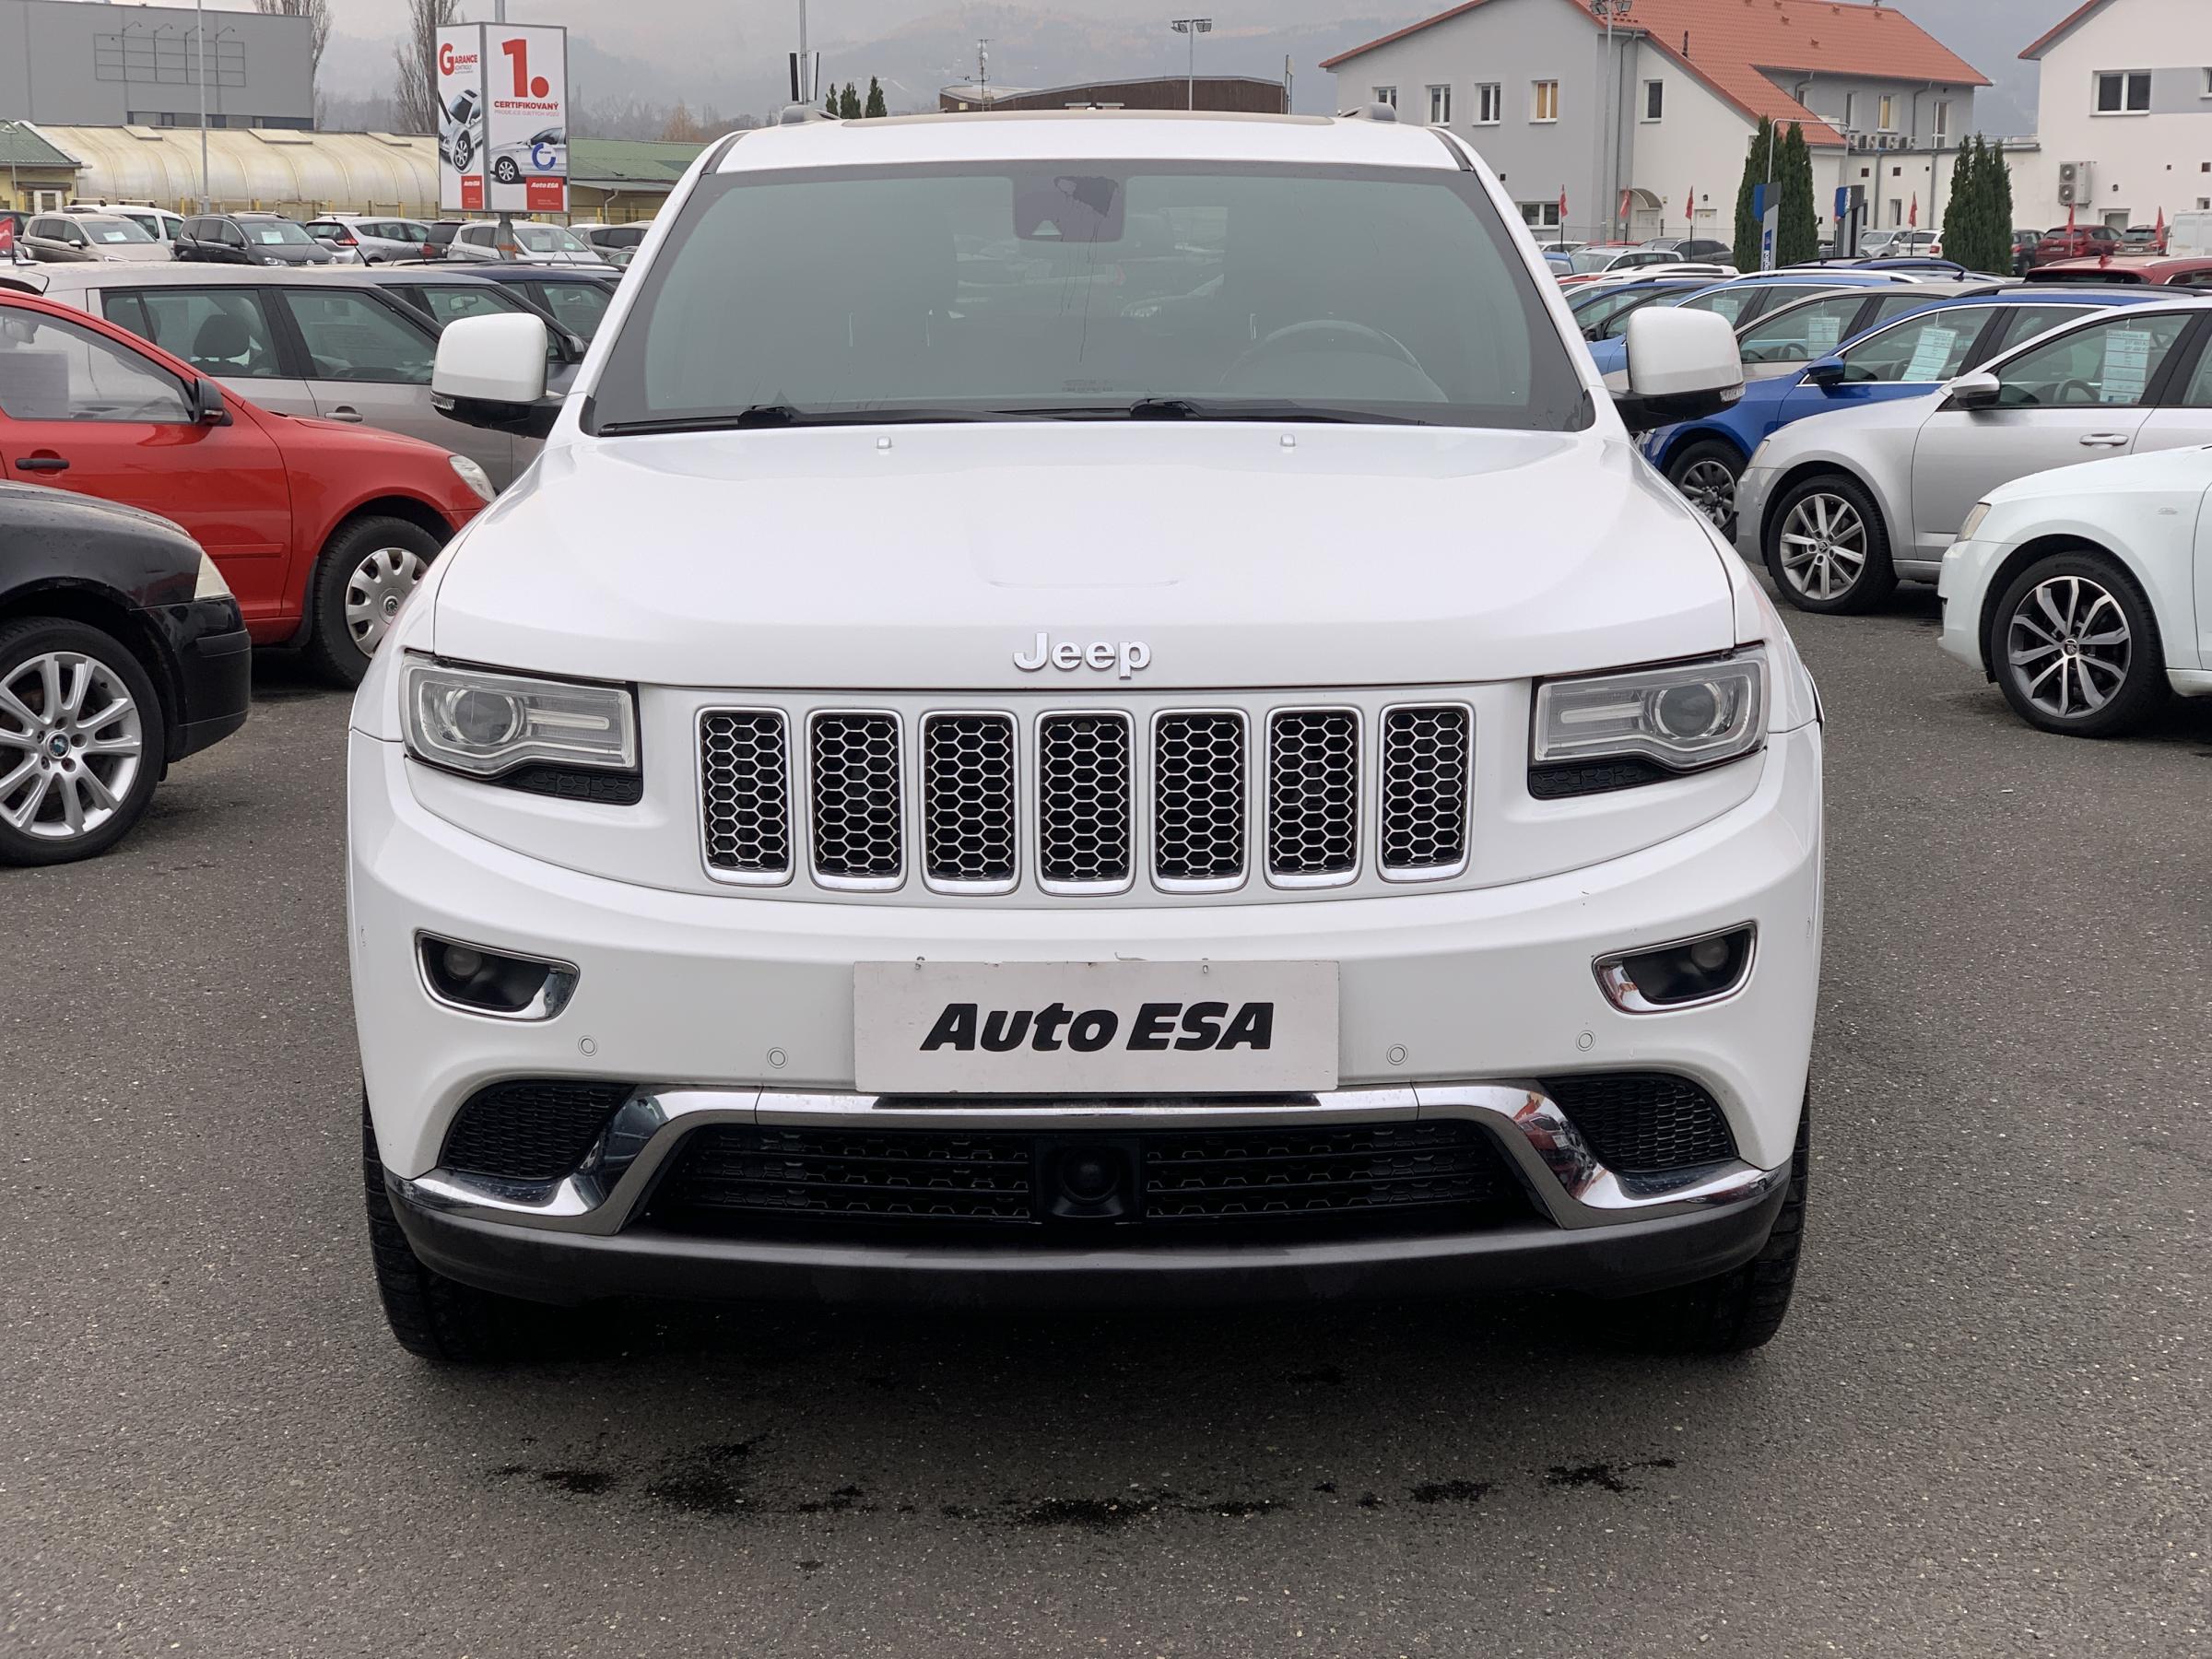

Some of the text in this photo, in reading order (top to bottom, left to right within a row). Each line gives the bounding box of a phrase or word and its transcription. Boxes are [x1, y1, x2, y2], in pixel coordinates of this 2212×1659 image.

[439, 42, 478, 76] GARANCE
[501, 39, 549, 98] 1.
[494, 100, 559, 110] CERTIFIKOVANÝ
[1013, 631, 1152, 680] Jeep
[920, 1001, 1275, 1053] Auto ESA
